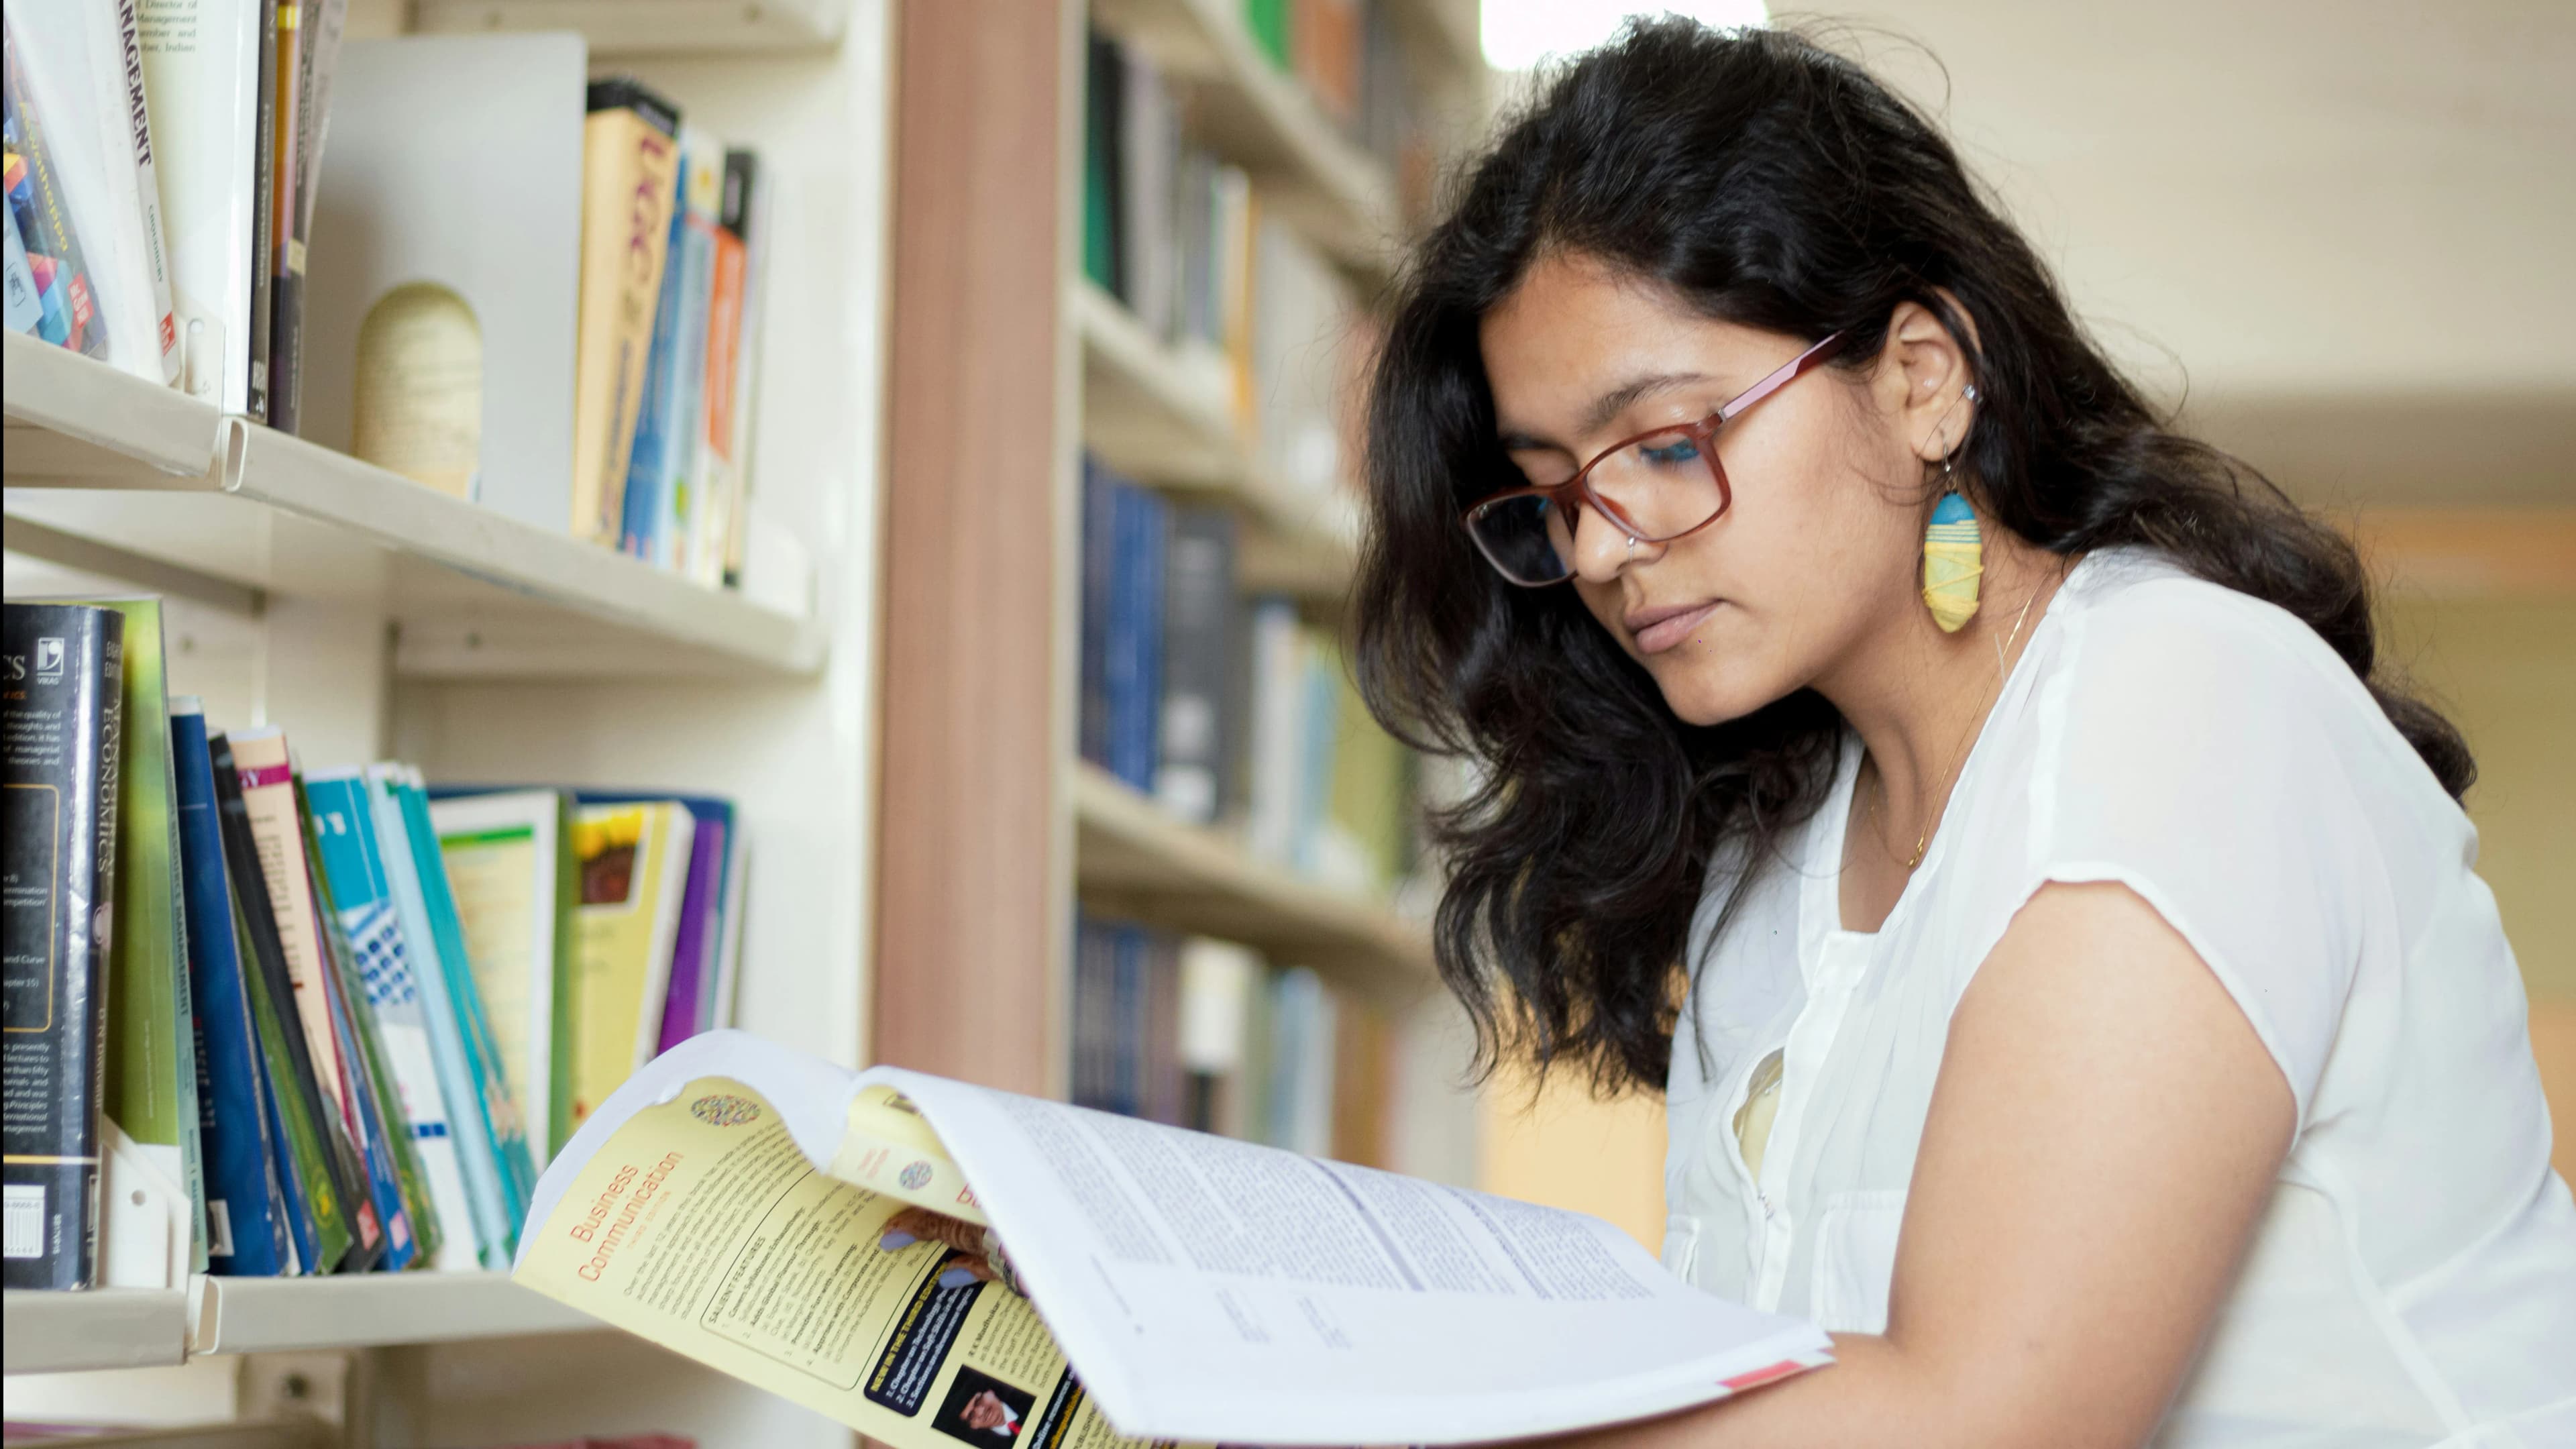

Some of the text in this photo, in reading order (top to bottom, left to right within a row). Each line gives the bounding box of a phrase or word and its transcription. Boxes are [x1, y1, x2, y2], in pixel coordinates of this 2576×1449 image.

[19, 102, 68, 252] Aswathappa
[44, 722, 61, 731] and
[43, 757, 59, 765] and
[98, 707, 114, 873] ECONOMICS
[21, 955, 46, 964] Curve
[173, 905, 190, 1017] MANAGEMENT
[32, 1078, 48, 1086] and
[570, 1163, 639, 1242] Business
[576, 1149, 684, 1279] Communication
[626, 1189, 671, 1250] THIRD EDITION
[623, 1275, 639, 1295] Over
[635, 1258, 649, 1275] the
[645, 1243, 658, 1259] last
[655, 1231, 665, 1244] 12
[664, 1210, 682, 1232] years
[677, 1195, 692, 1212] this
[688, 1177, 705, 1197] book
[635, 1249, 668, 1301] authoritative
[665, 1214, 692, 1250] approach
[692, 1194, 707, 1209] has
[645, 1173, 740, 1305] management and other professional
[657, 1286, 676, 1310] sharp
[671, 1262, 688, 1287] focus
[686, 1251, 696, 1263] on
[692, 1240, 702, 1251] all
[698, 1210, 724, 1240] relevant
[720, 1180, 751, 1211] concepts
[679, 1208, 754, 1320] students to communicate with
[668, 1255, 708, 1317] understanding
[702, 1247, 712, 1257] of
[707, 1234, 721, 1250] the
[708, 1236, 765, 1322] SALIENT FEATURES
[727, 1250, 773, 1318] Covers Syllabuses
[748, 1304, 765, 1327] Adds
[761, 1279, 780, 1306] Global
[776, 1250, 798, 1280] Flavour
[766, 1293, 786, 1322] Expert
[804, 1233, 824, 1257] Quote
[784, 1267, 826, 1332] Margin Elements
[812, 1247, 880, 1354] Apprises with Corporate and
[943, 1301, 953, 1313] in
[790, 1309, 814, 1345] Provides
[810, 1293, 824, 1311] Fun
[819, 1275, 834, 1294] with
[806, 1299, 833, 1341] Laugh and
[827, 1328, 843, 1349] From
[839, 1313, 851, 1328] the
[847, 1277, 873, 1314] Corporate
[837, 1332, 853, 1354] From
[848, 1318, 861, 1334] the
[856, 1281, 882, 1319] Academic
[870, 1259, 950, 1392] NEW IN THE THIRD EDITION
[909, 1364, 931, 1399] Sections
[926, 1353, 937, 1368] on
[932, 1328, 951, 1356] eleven
[947, 1310, 961, 1332] new
[955, 1285, 975, 1313] topics
[912, 1299, 942, 1347] Technology
[922, 1333, 936, 1352] Soft
[930, 1309, 948, 1336] Skills
[974, 1299, 1001, 1342] Madhukar
[982, 1317, 1004, 1352] Business
[994, 1320, 1015, 1355] alumnus
[889, 1354, 912, 1391] Chapter
[899, 1360, 922, 1395] Chapter
[907, 1344, 918, 1358] on
[917, 1350, 928, 1363] on
[1004, 1337, 1018, 1356] Staff
[1007, 1356, 1020, 1375] with
[1018, 1353, 1035, 1379] Indian
[1047, 1379, 1071, 1422] resources
